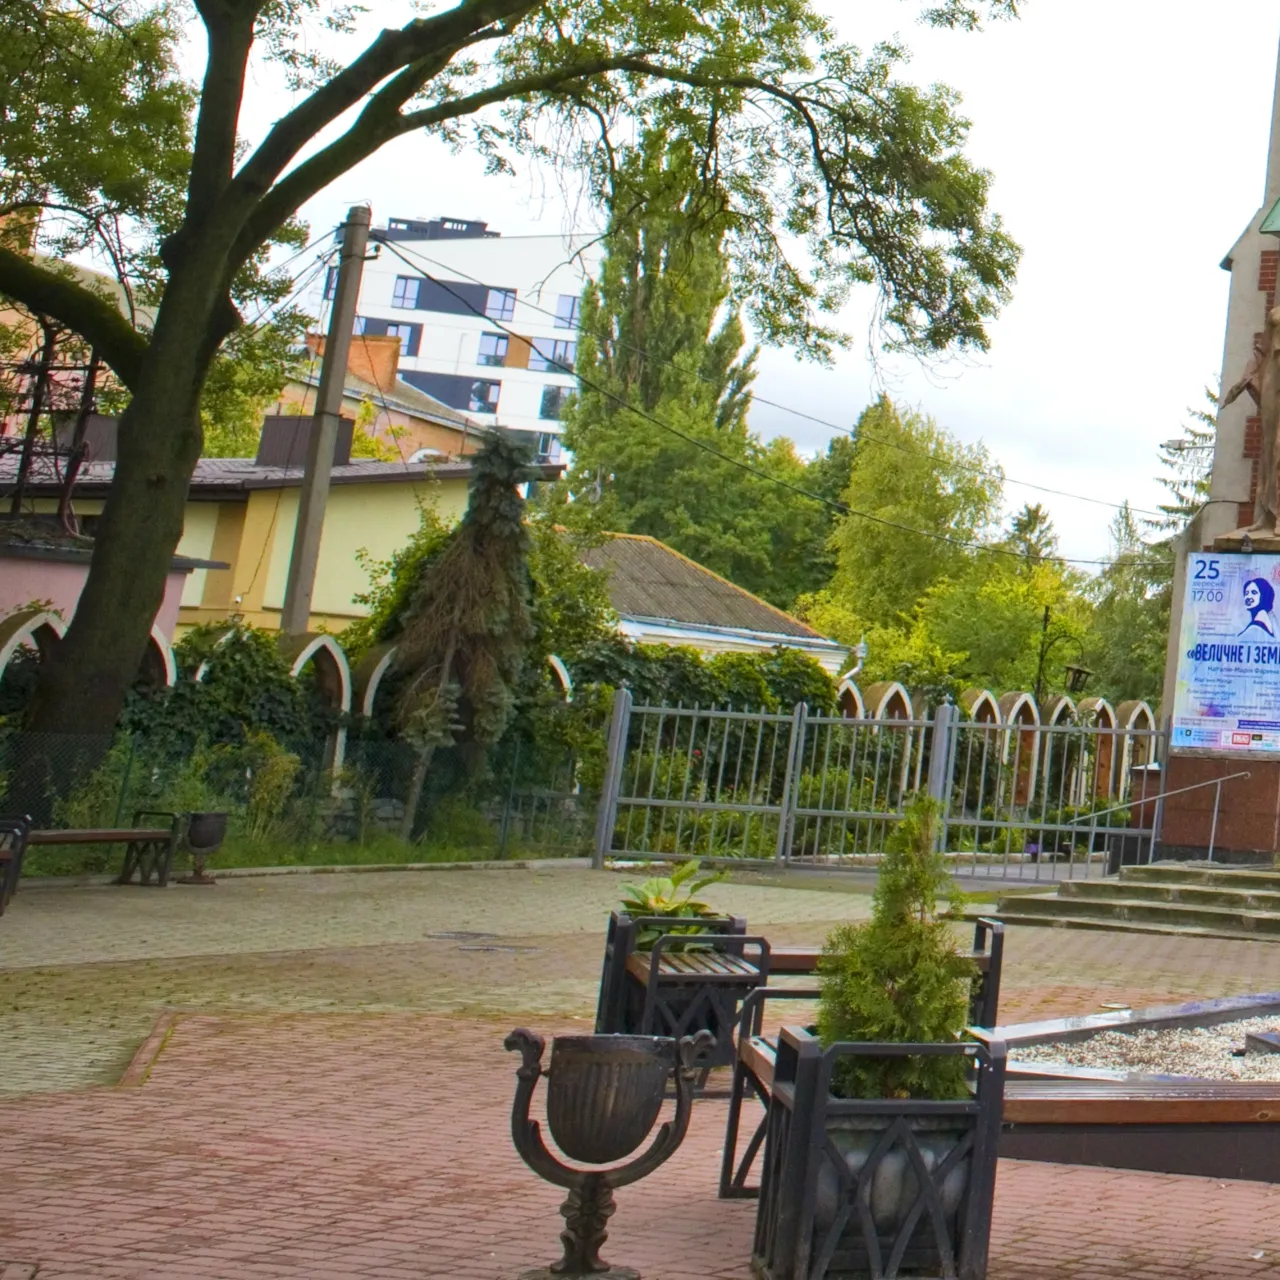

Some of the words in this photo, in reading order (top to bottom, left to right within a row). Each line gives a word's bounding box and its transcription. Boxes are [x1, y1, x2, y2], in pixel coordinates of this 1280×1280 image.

[1194, 560, 1220, 579] 25
[1192, 590, 1223, 602] 17.00
[1187, 643, 1244, 663] «ВЕЛИЧНЕ
